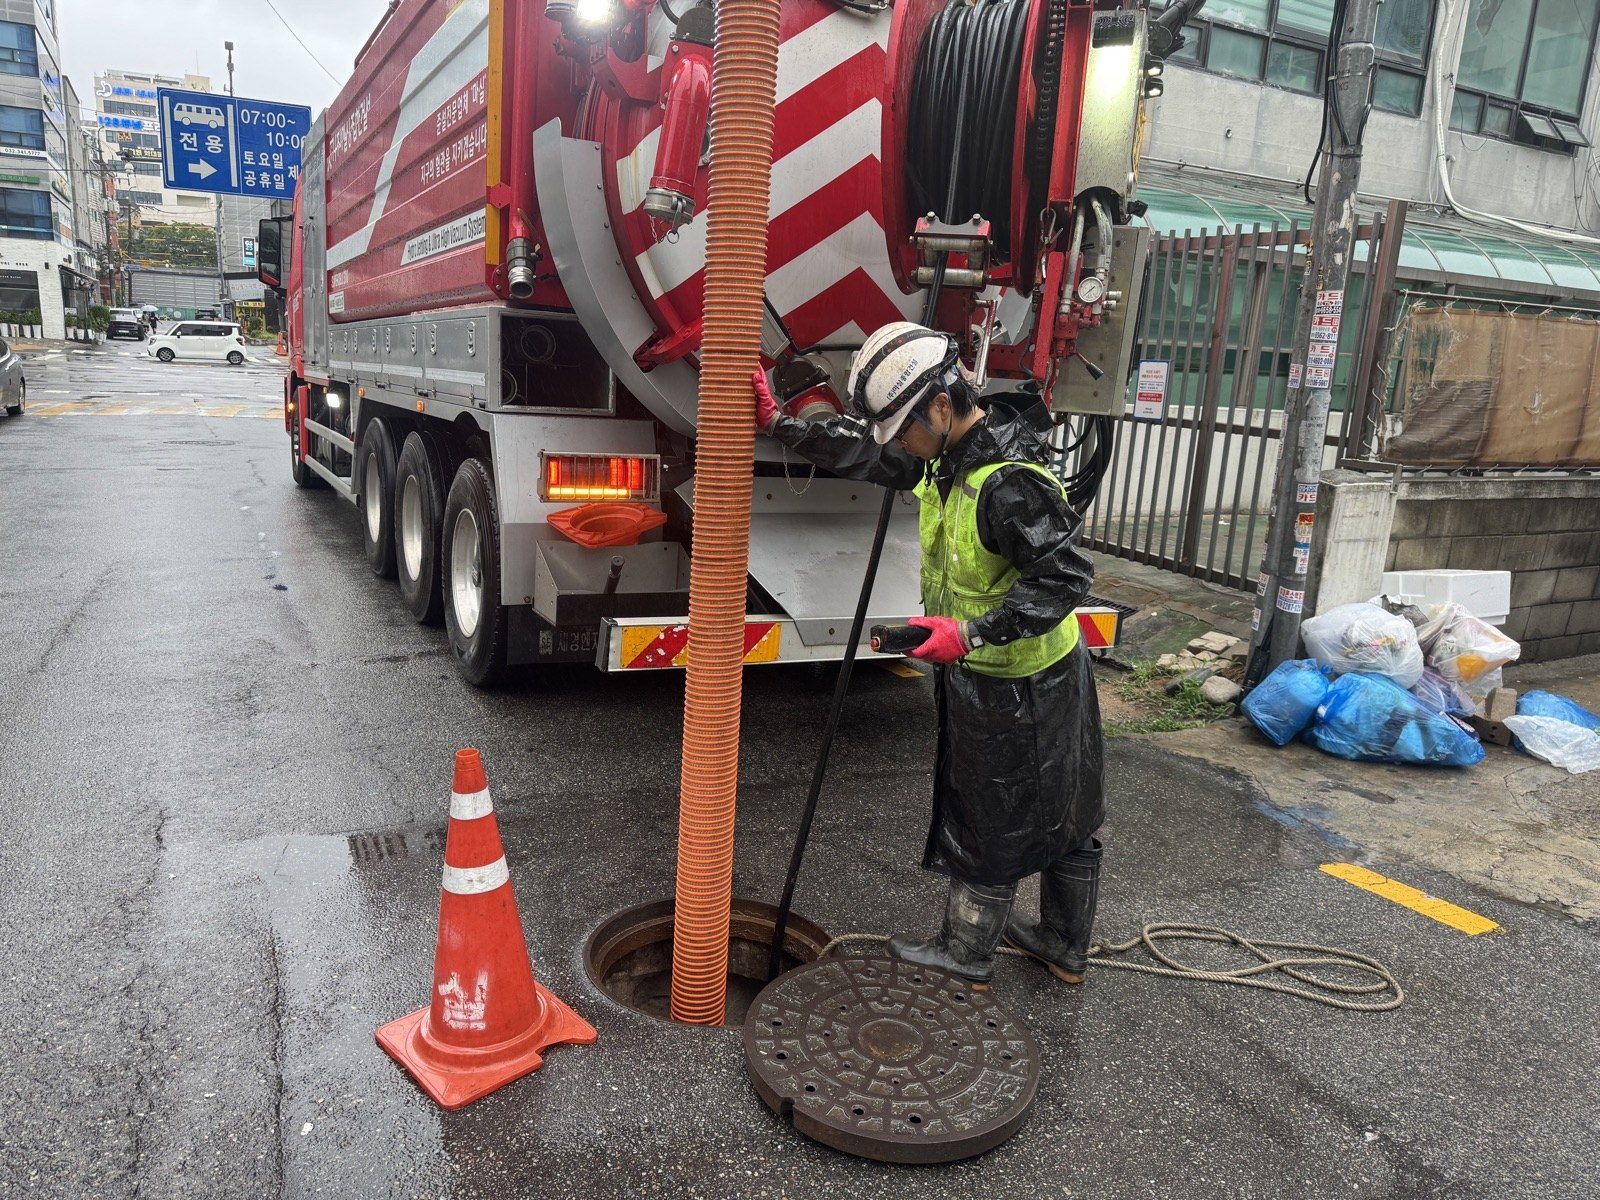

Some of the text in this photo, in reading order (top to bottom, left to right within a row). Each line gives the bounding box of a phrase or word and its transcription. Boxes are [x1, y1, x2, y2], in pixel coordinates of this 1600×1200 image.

[241, 109, 296, 128] 07:00~
[437, 89, 469, 136] 준설전문업체
[180, 132, 224, 154] 전용
[421, 121, 487, 186] 지구의 혈관을 지키겠습니다
[243, 151, 284, 169] 토요일
[244, 170, 285, 190] 공휴일
[450, 222, 467, 245] Vacuum
[468, 215, 486, 240] System
[1298, 493, 1317, 502] 카드
